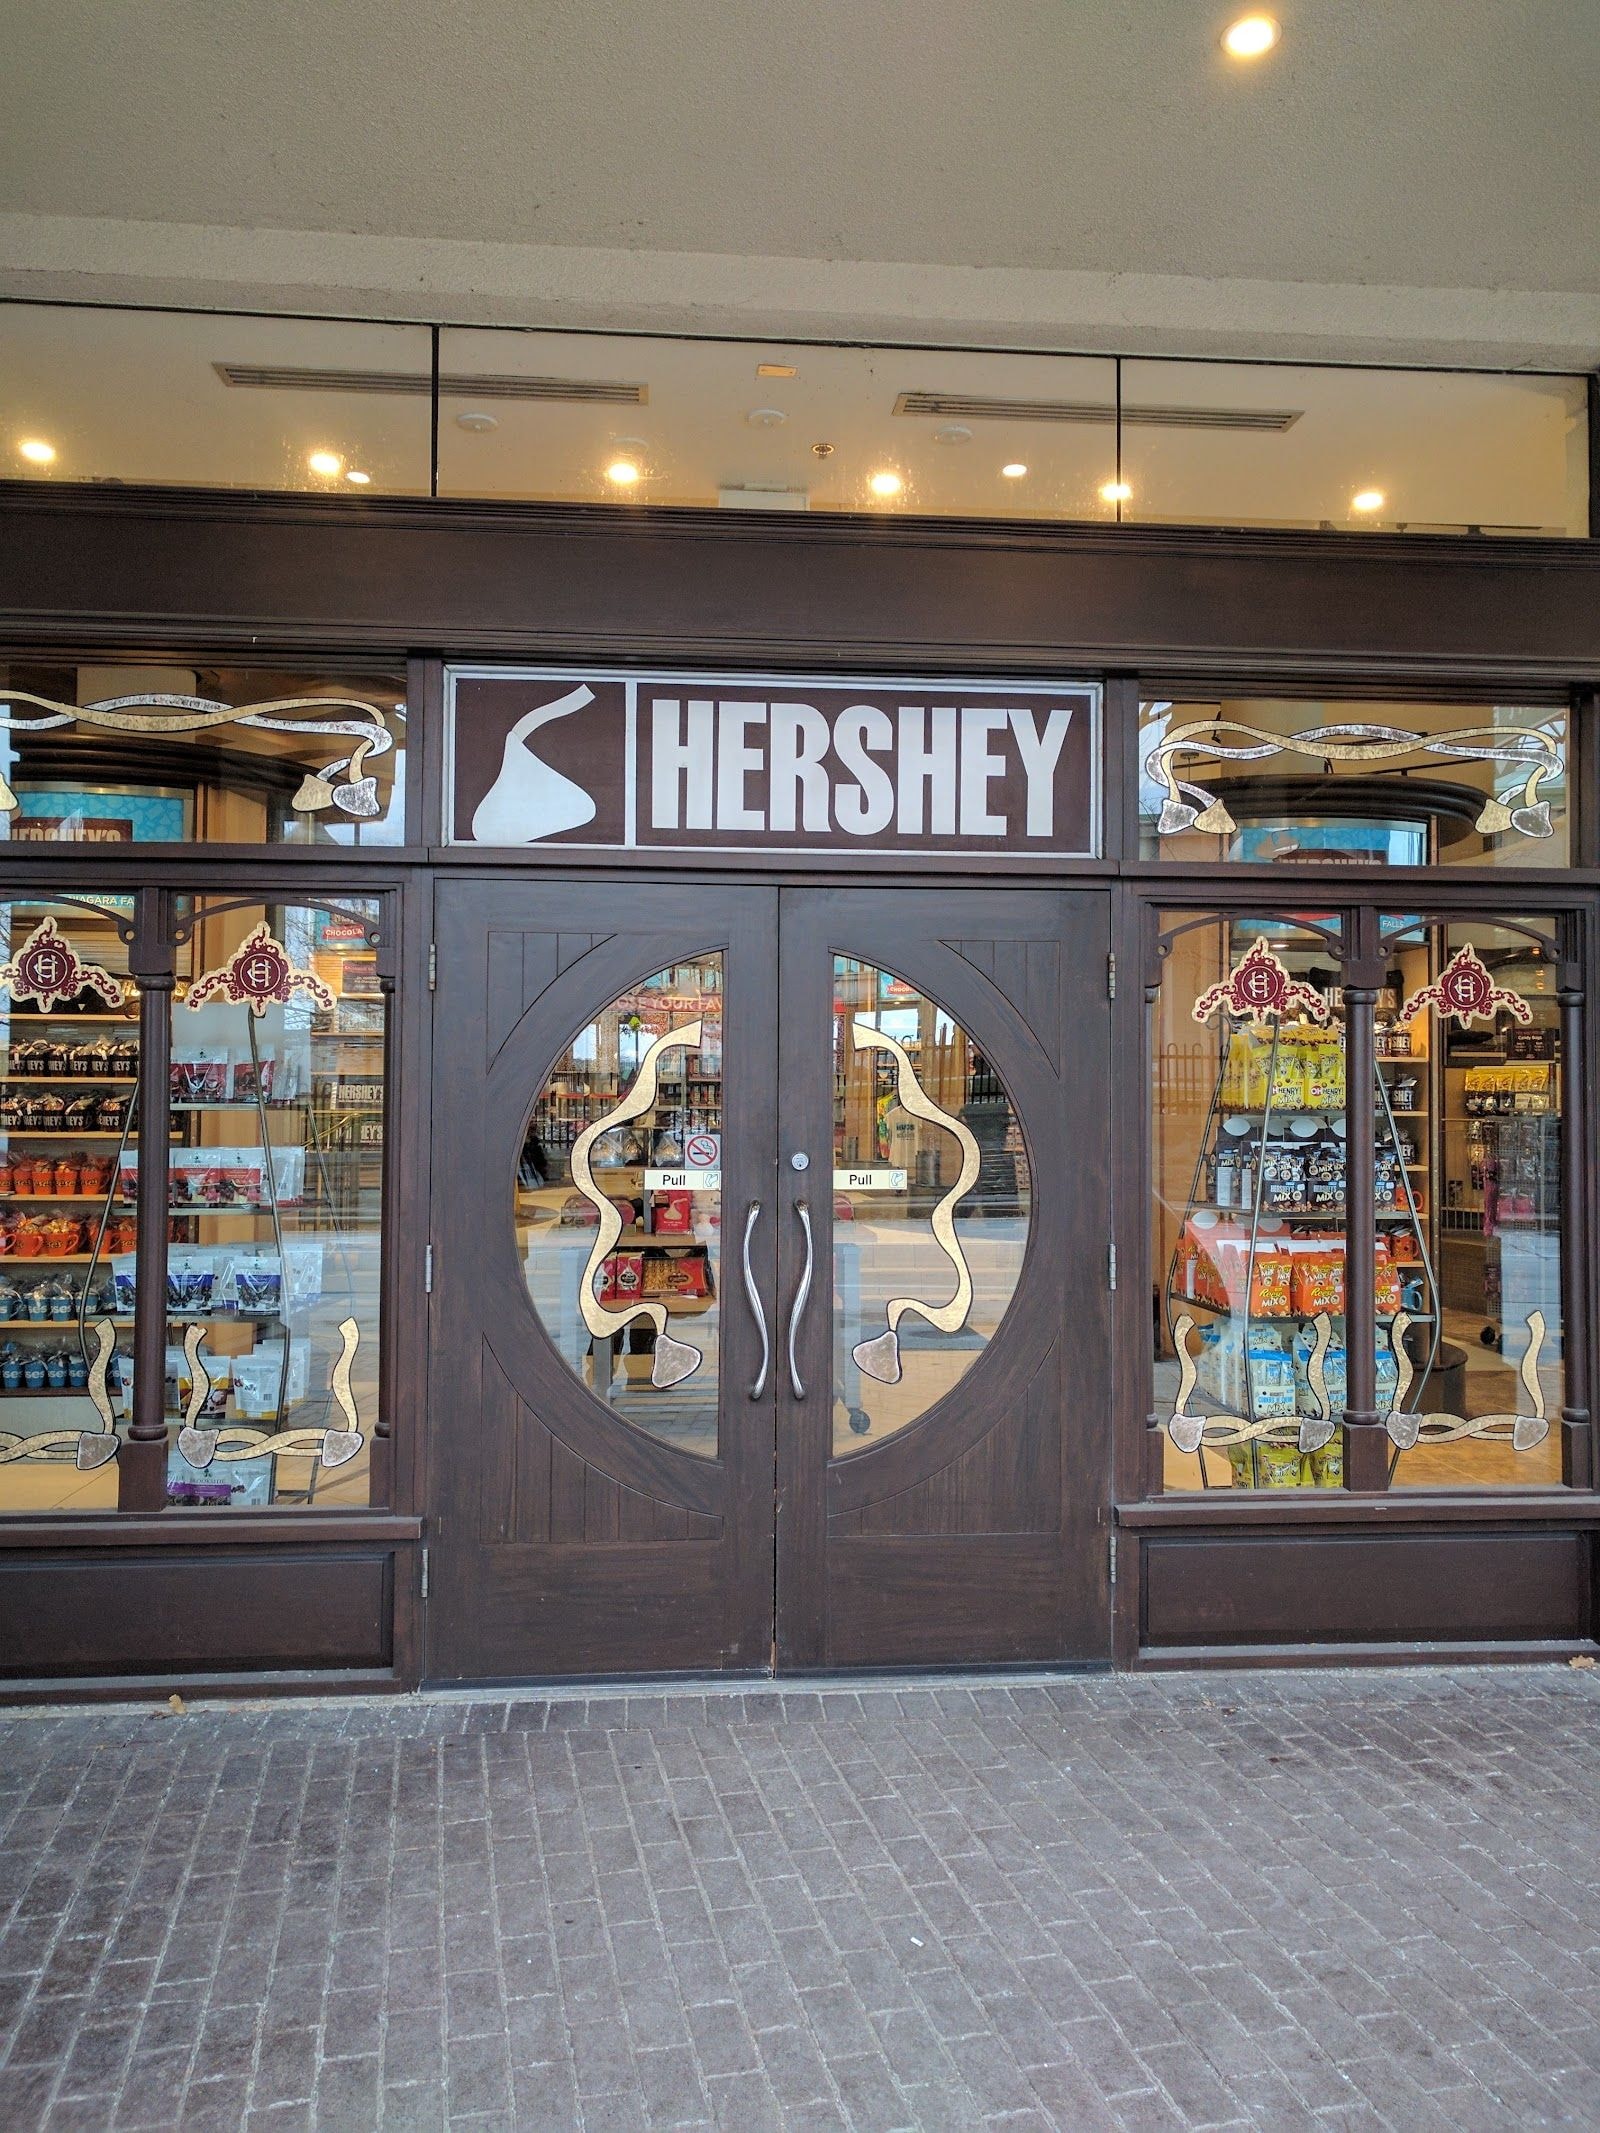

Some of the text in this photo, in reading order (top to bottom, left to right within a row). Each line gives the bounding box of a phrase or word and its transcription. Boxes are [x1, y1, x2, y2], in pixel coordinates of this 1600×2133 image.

[651, 698, 1073, 837] HERSHEY
[662, 1175, 686, 1186] Pull
[849, 1174, 872, 1185] Pull
